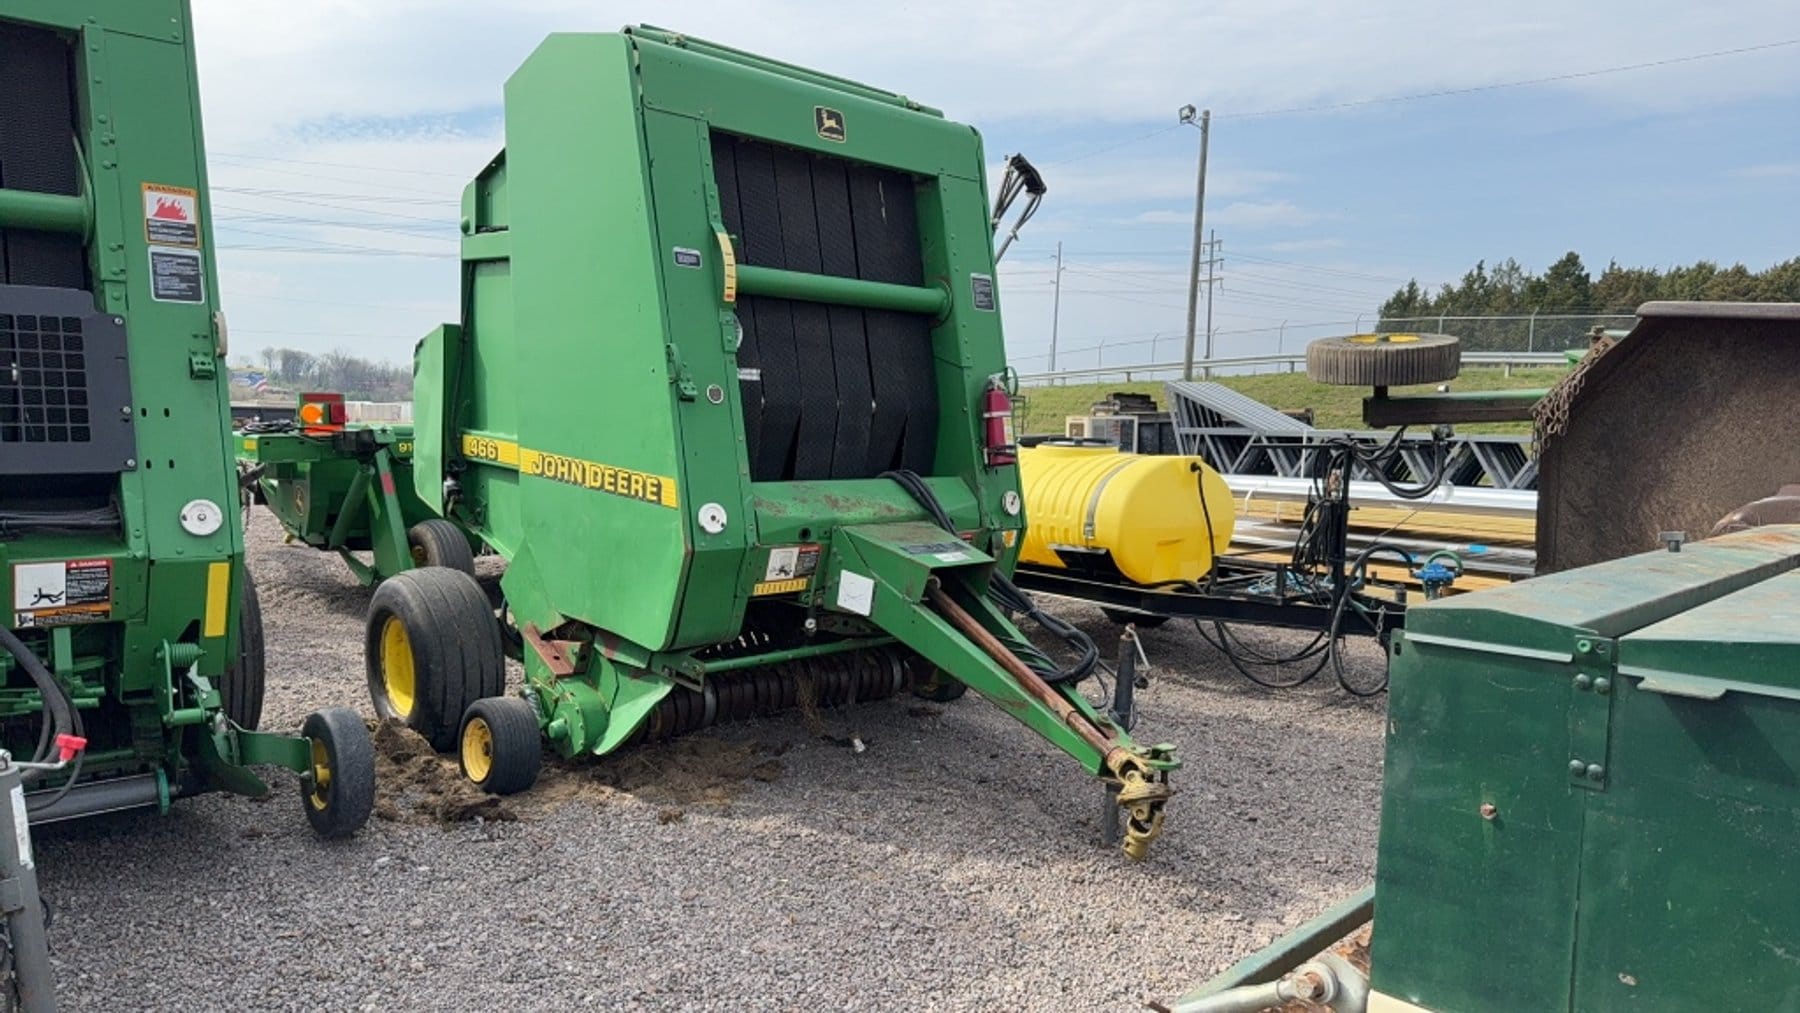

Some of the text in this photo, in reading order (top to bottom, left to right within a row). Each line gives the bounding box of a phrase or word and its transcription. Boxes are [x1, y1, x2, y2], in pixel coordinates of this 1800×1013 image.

[470, 438, 498, 460] 466
[532, 453, 662, 504] JOHN DEERE
